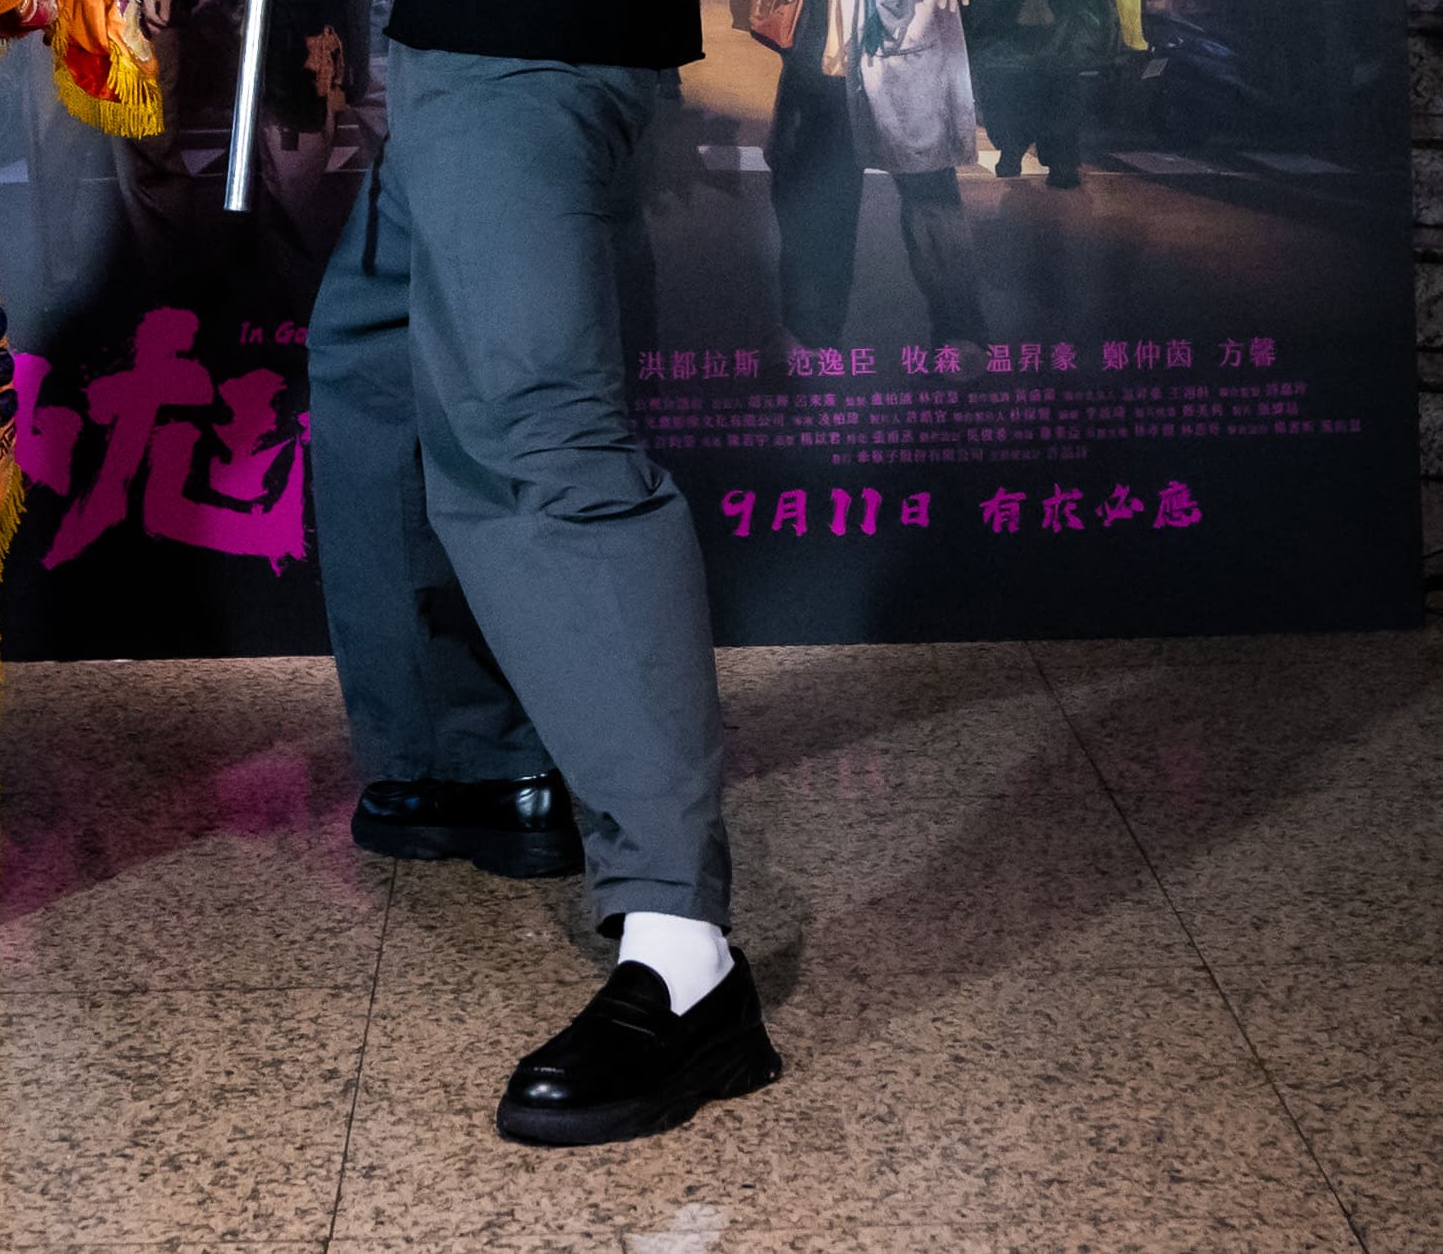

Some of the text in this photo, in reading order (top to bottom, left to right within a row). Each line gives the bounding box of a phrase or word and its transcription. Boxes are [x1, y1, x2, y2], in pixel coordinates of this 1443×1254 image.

[239, 320, 309, 345] In Go
[638, 348, 759, 380] 洪都拉斯
[787, 347, 876, 377] 范逸臣
[901, 344, 961, 374] 牧森
[1102, 339, 1193, 372] 鄭仲茵
[1219, 337, 1276, 368] 方馨
[721, 479, 1203, 538] 9月11日 有求必應
